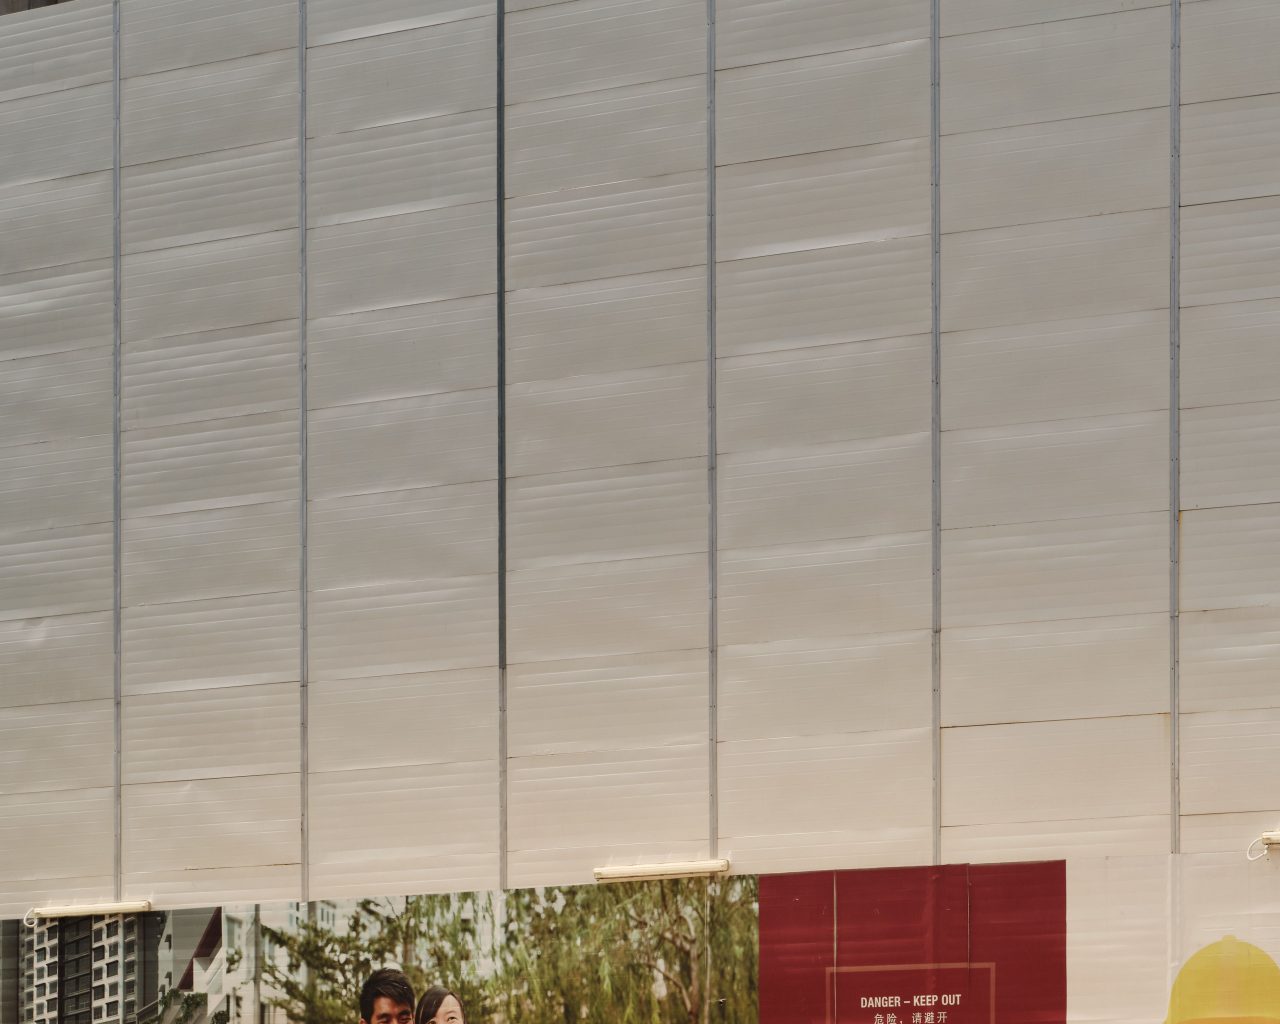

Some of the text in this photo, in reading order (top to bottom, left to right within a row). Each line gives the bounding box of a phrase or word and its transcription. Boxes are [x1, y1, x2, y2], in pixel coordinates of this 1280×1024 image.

[860, 996, 901, 1008] DANGER
[913, 995, 939, 1007] KEEP
[941, 994, 962, 1006] OUT
